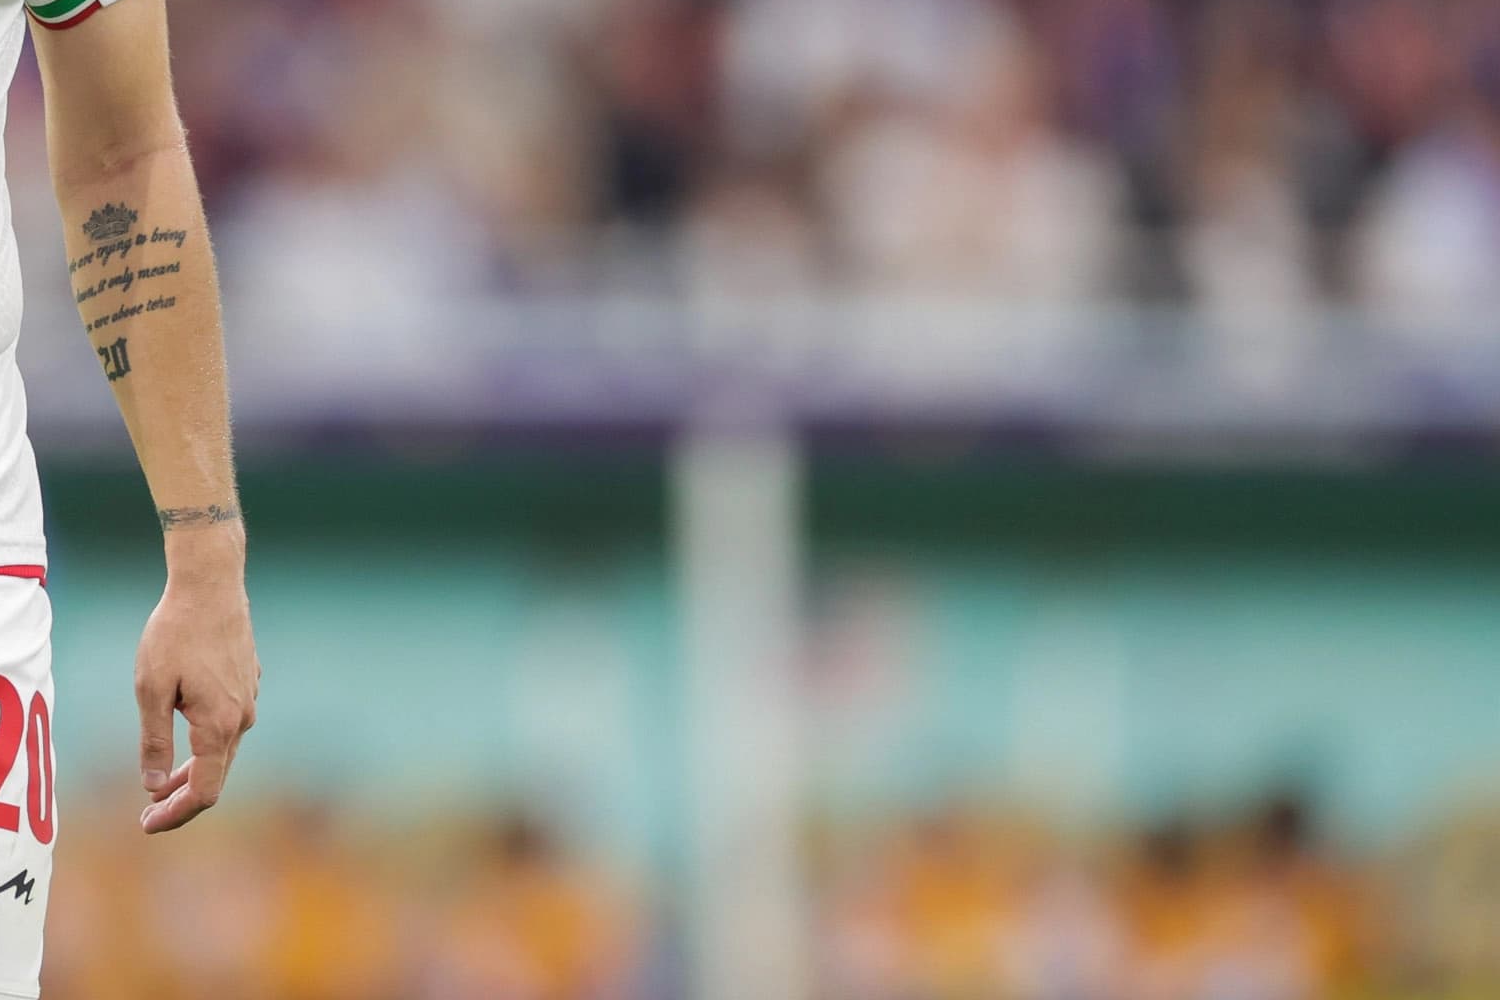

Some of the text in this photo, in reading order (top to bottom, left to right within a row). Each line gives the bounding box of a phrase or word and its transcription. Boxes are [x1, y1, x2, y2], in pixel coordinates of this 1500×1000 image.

[149, 226, 187, 248] bring
[108, 266, 134, 293] only
[137, 261, 181, 281] means
[93, 314, 111, 330] are
[111, 304, 144, 323] above
[97, 336, 132, 382] 20
